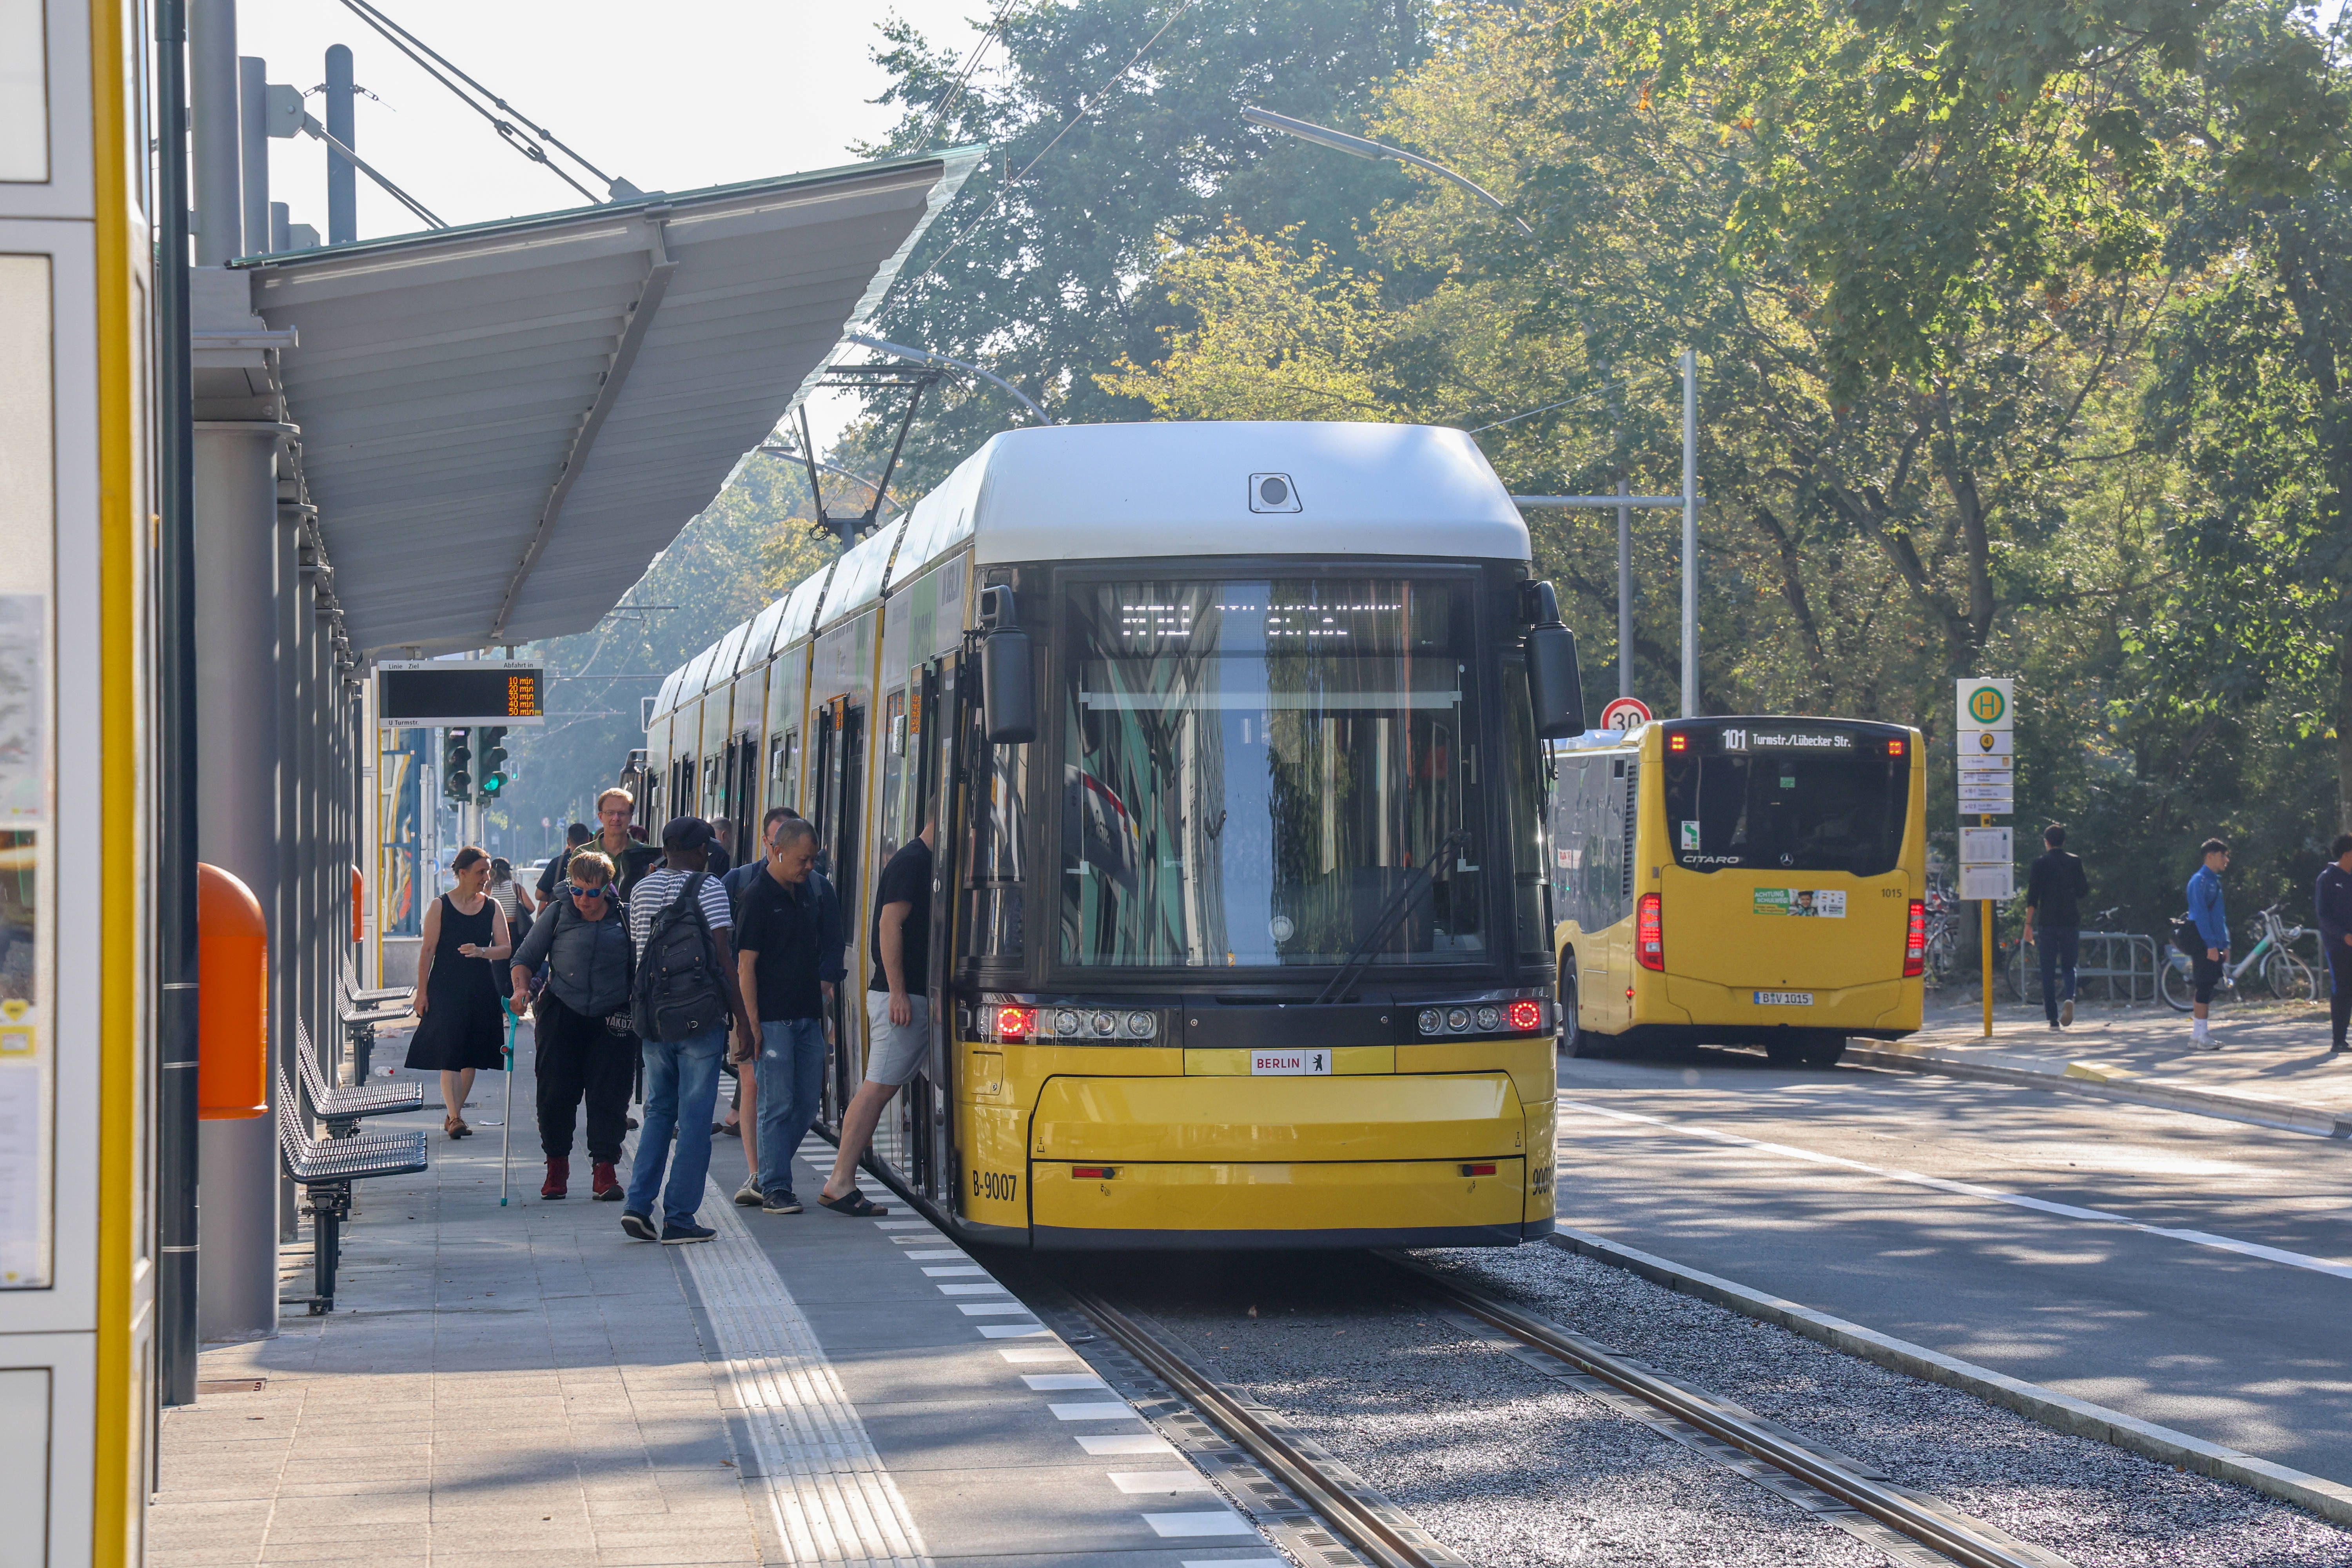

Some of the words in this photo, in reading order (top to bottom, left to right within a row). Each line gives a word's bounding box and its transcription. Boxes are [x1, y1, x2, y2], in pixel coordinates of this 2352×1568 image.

[1613, 713, 1640, 730] 30
[1722, 730, 1746, 749] 101
[1753, 734, 1832, 747] Turmstr./Lübecker
[1834, 736, 1851, 747] Str.
[1683, 855, 1739, 864] CITARO
[1882, 889, 1902, 897] 1015
[1764, 993, 1769, 1002] B
[1776, 994, 1782, 1003] V
[1785, 994, 1808, 1004] 1015
[605, 1016, 633, 1029] YAKUZ
[1257, 1058, 1299, 1068] BERLIN
[973, 1170, 1016, 1201] B-9007
